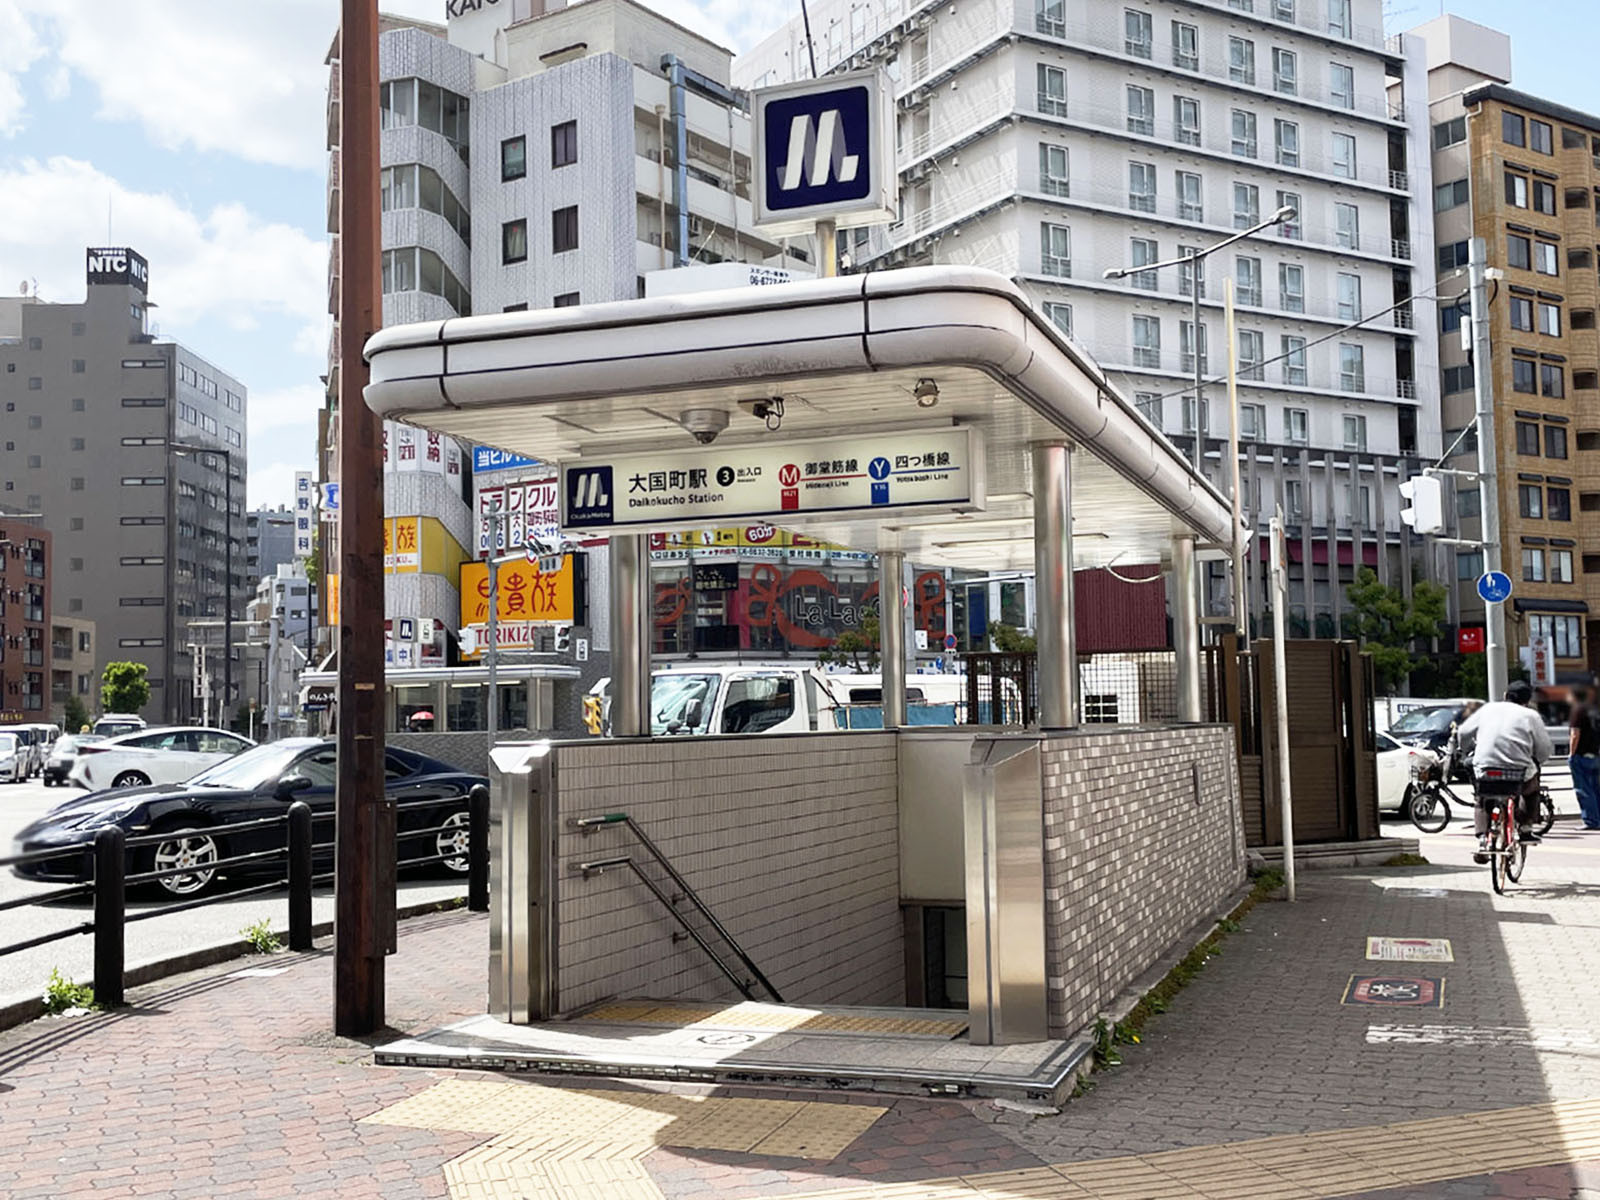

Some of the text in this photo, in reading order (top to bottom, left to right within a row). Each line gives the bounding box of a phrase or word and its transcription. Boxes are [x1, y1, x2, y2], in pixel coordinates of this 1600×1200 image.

[89, 256, 128, 272] NTC
[896, 452, 950, 468] 四つ橋線
[781, 467, 797, 484] M
[873, 460, 886, 478] Y
[629, 468, 708, 493] 大国町駅
[629, 493, 724, 507] Daikokucho Station
